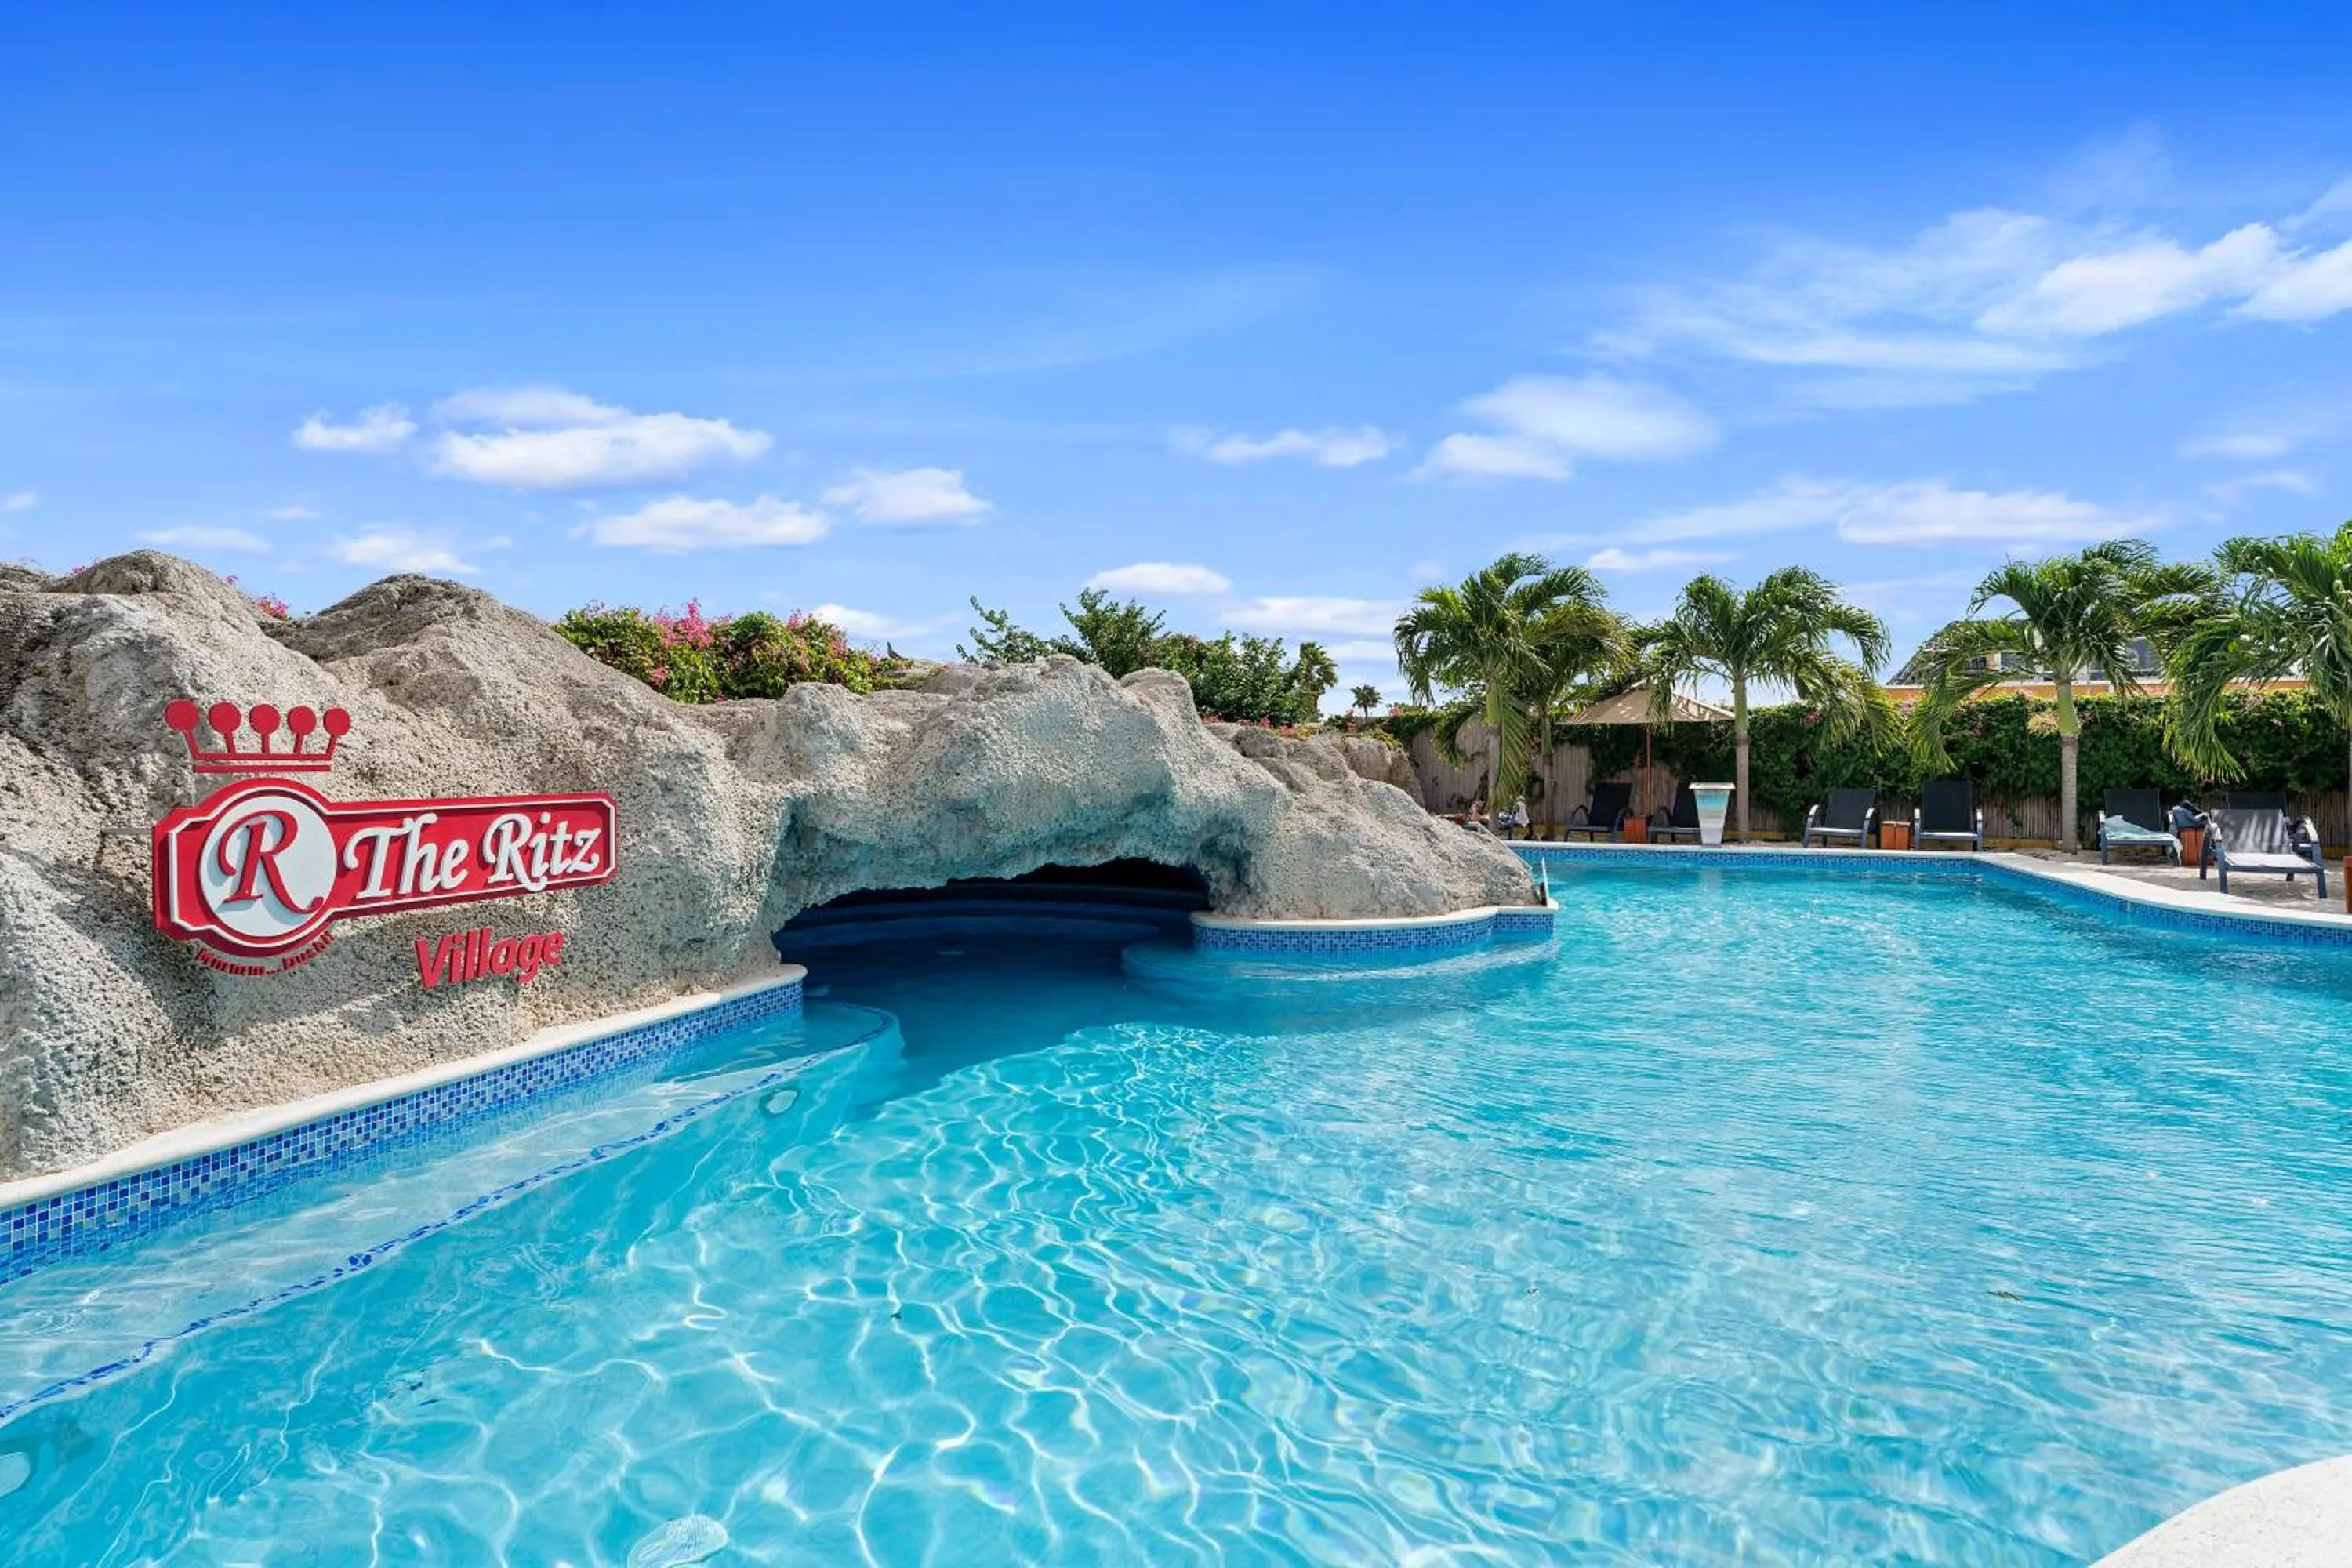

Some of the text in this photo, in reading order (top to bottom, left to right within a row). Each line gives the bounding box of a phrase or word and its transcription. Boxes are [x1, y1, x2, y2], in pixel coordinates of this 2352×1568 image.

[217, 810, 324, 914] R
[343, 811, 601, 899] The Ritz
[414, 927, 564, 990] Village
